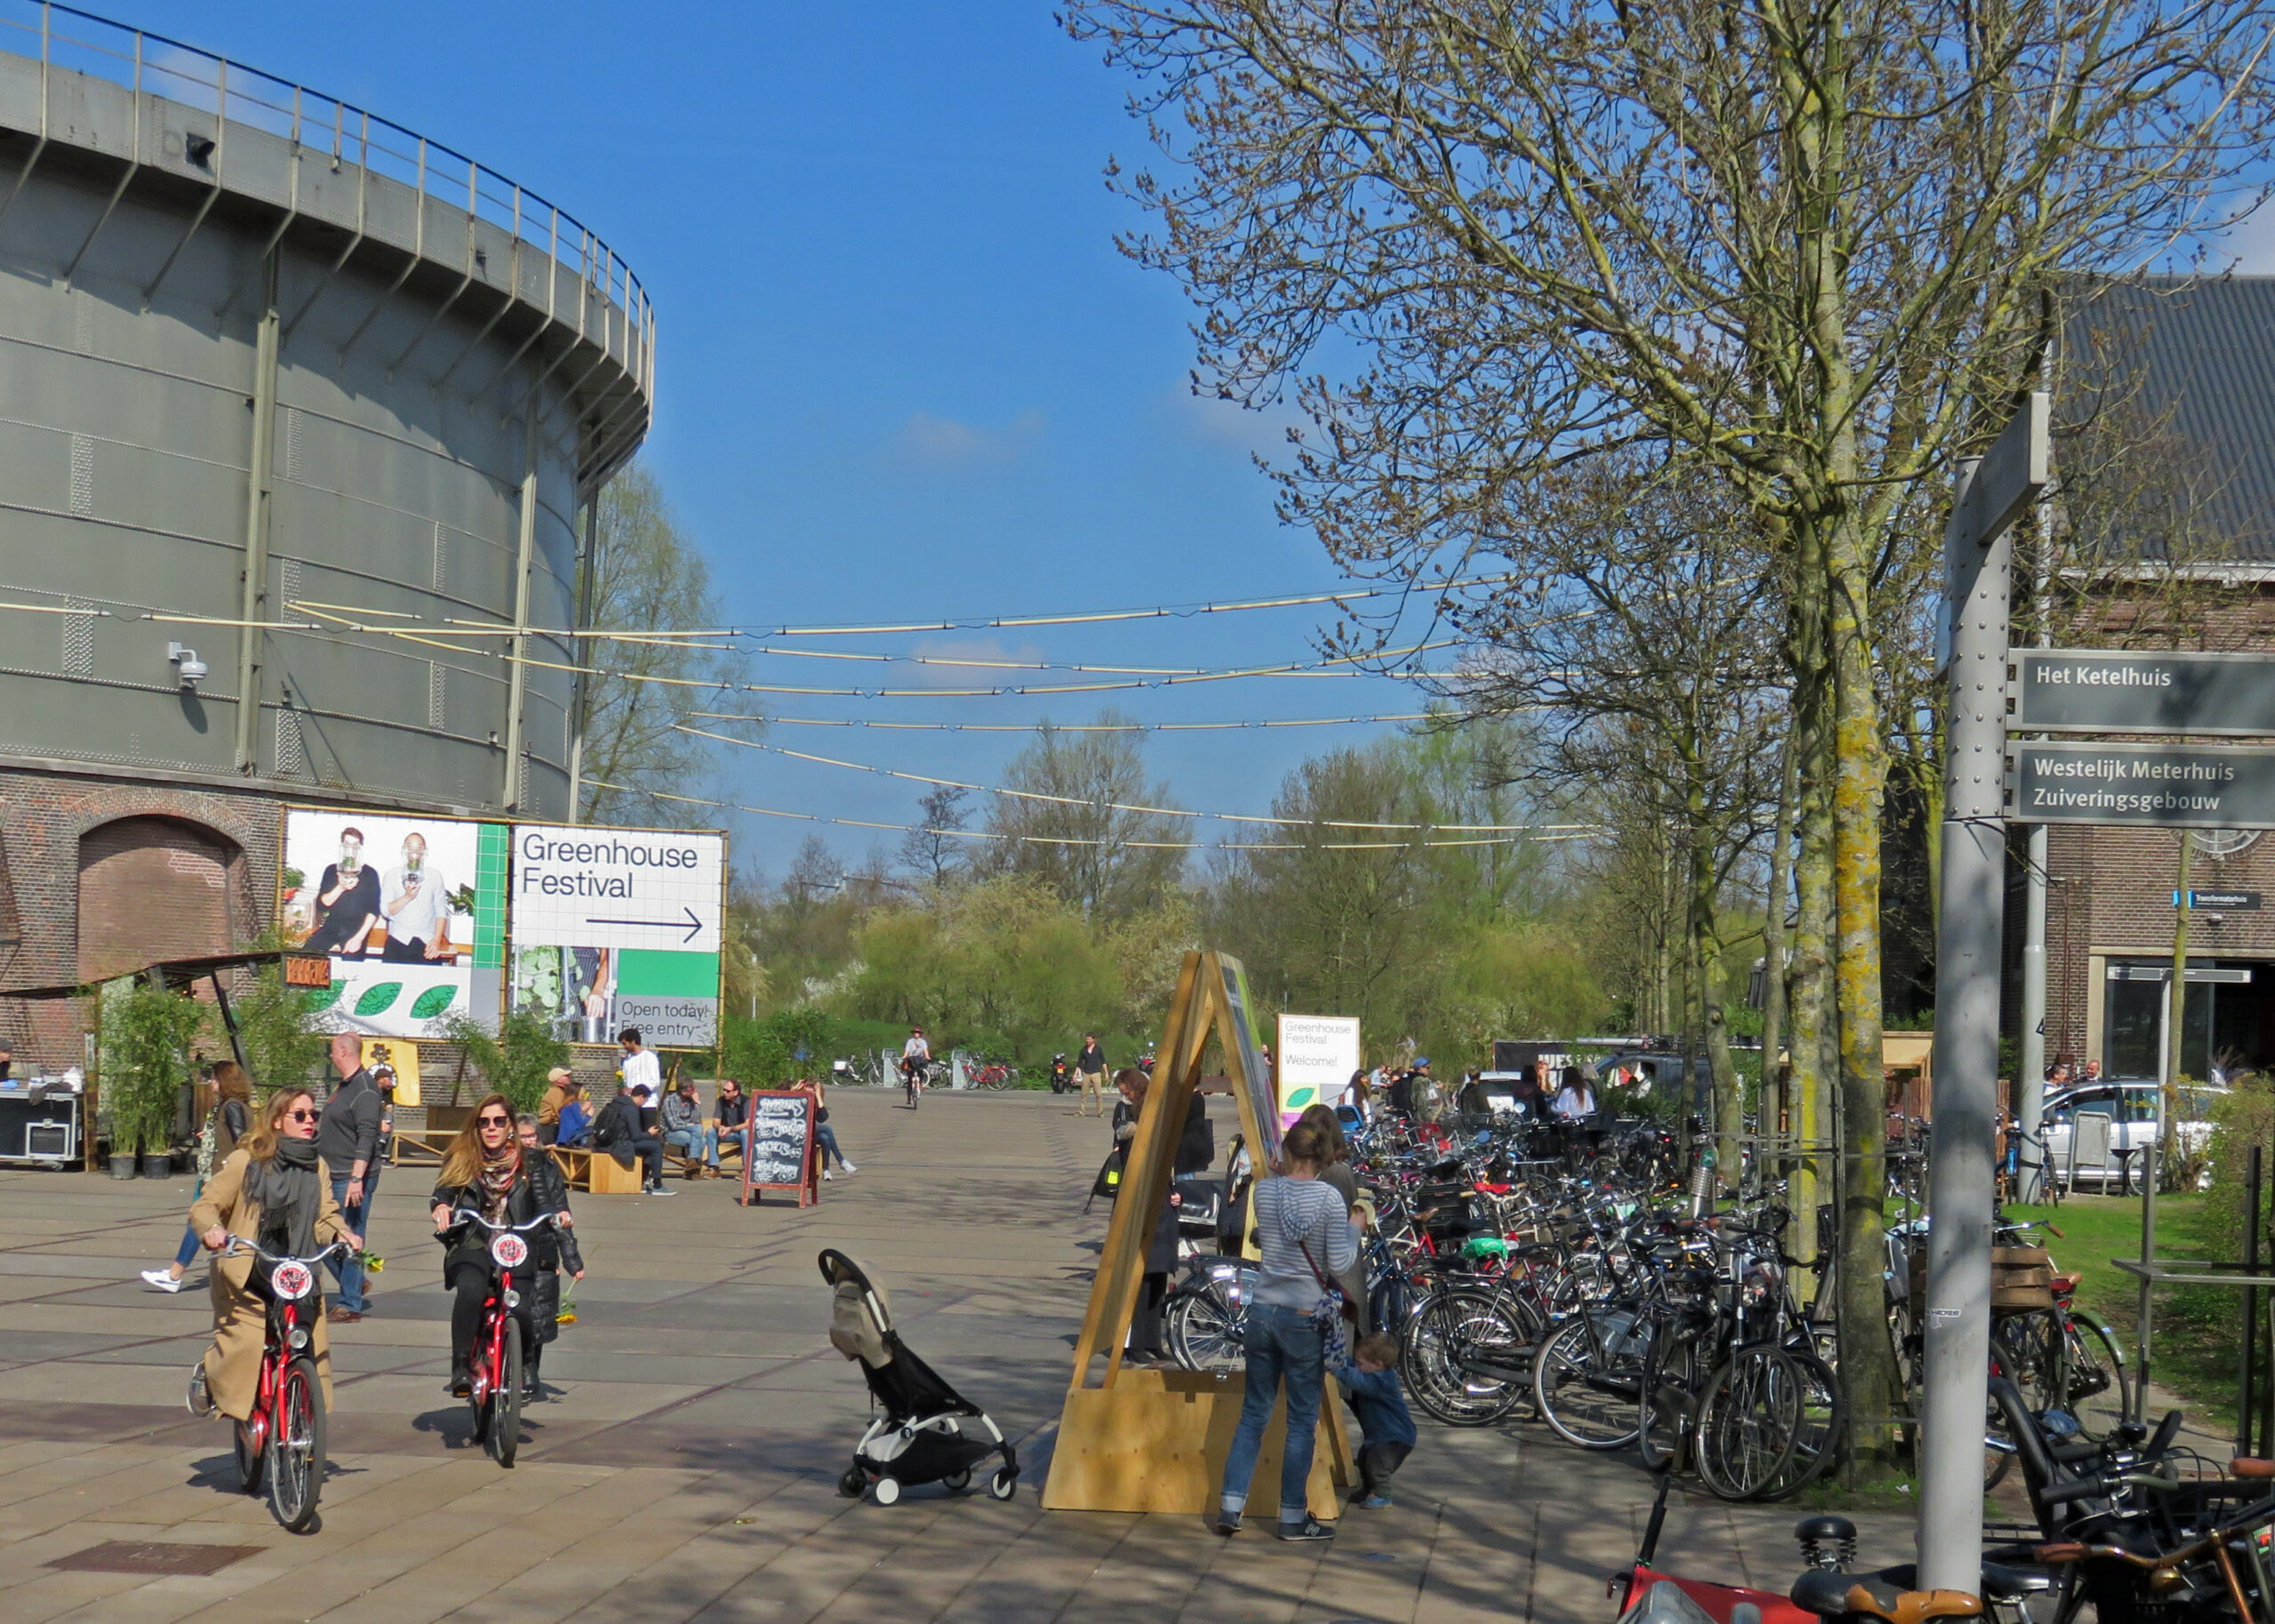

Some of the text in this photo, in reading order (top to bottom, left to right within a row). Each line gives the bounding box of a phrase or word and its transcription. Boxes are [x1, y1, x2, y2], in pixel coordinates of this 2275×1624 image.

[2036, 667, 2171, 687] Het Ketelhuis
[2034, 759, 2235, 782] Westelijk Meterhuis
[2033, 788, 2220, 812] Zuiveringsgebouw
[523, 833, 698, 869] Greenhouse
[523, 867, 633, 898] Festival
[369, 983, 399, 1015] GROW
[622, 997, 707, 1023] Open today!
[658, 1023, 695, 1039] entry
[1286, 1021, 1351, 1034] Greenhouse
[1286, 1033, 1327, 1045] Festival
[1286, 1055, 1337, 1066] Welcome!
